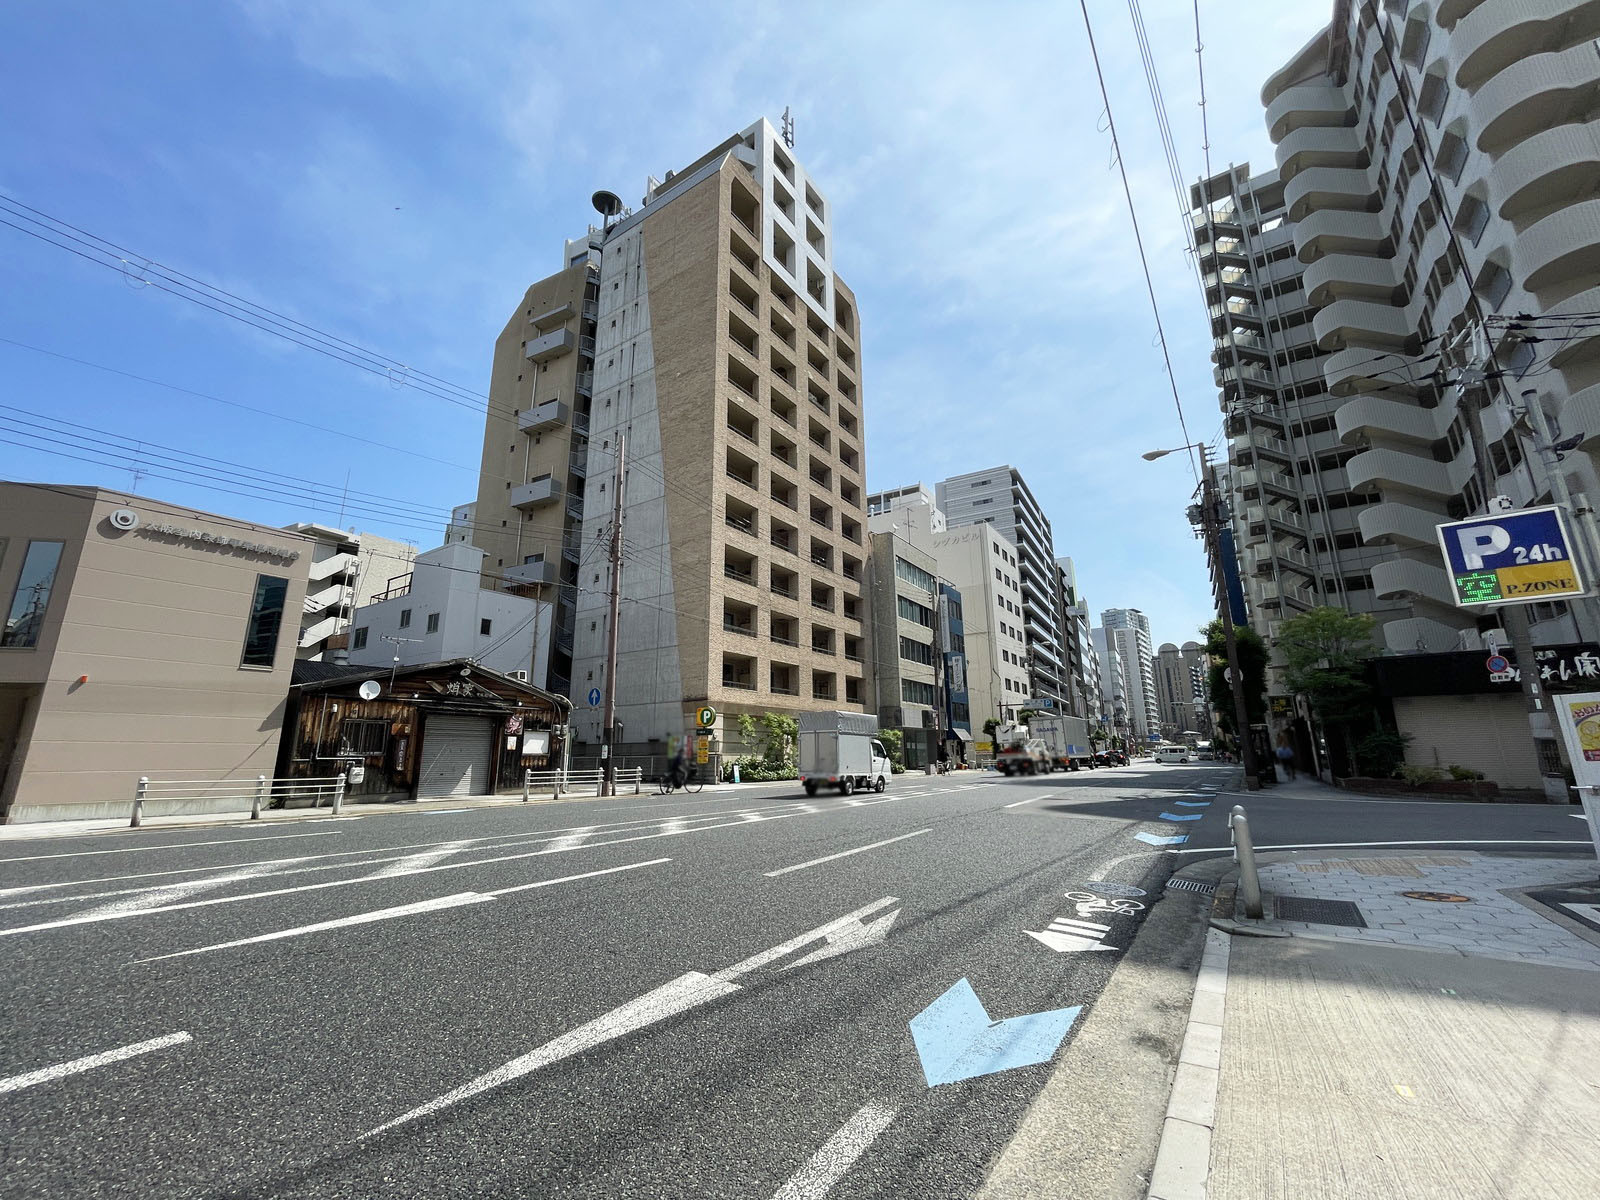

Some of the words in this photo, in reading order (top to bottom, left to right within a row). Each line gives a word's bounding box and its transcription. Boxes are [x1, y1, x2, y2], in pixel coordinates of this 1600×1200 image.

[1456, 525, 1511, 571] P
[1513, 544, 1563, 565] 24h
[1456, 573, 1502, 603] 空
[1507, 578, 1574, 594] P.ZONE
[703, 710, 711, 724] P
